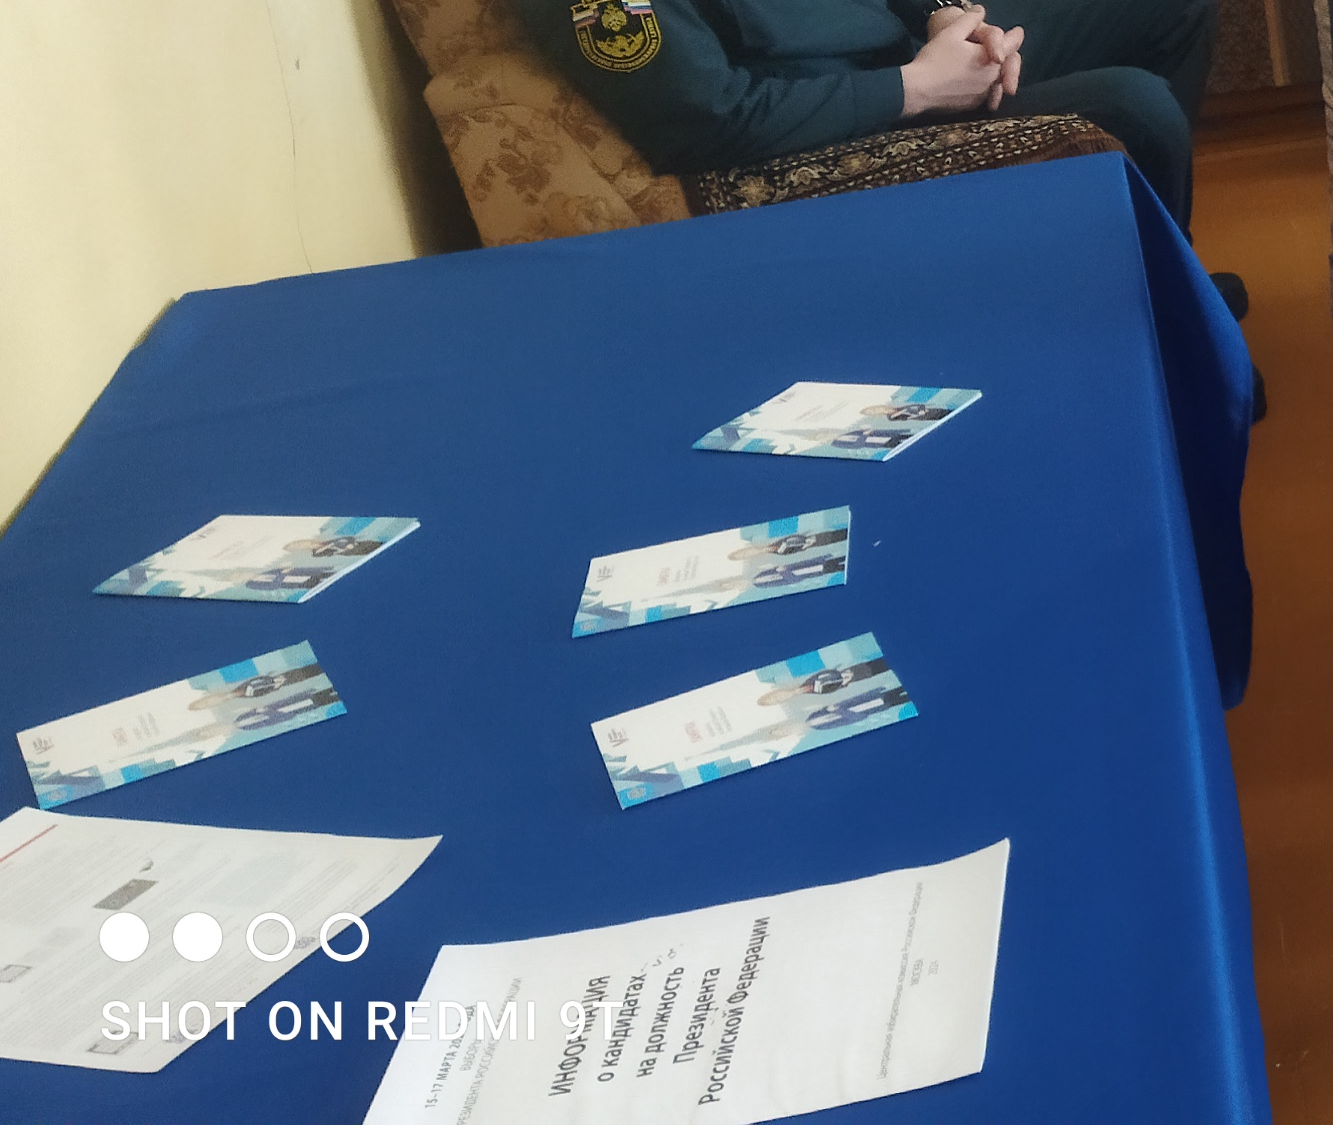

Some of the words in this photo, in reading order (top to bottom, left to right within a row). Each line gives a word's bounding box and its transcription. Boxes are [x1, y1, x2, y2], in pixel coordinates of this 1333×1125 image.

[601, 973, 647, 1069] кандидатах
[644, 966, 685, 1054] должность
[673, 967, 721, 1064] Президента
[698, 1006, 745, 1106] Российской
[728, 916, 771, 1005] Федерации
[436, 1050, 458, 1081] МАРТА
[456, 1076, 485, 1125] РЕЗИДЕНТА
[637, 1057, 658, 1078] на
